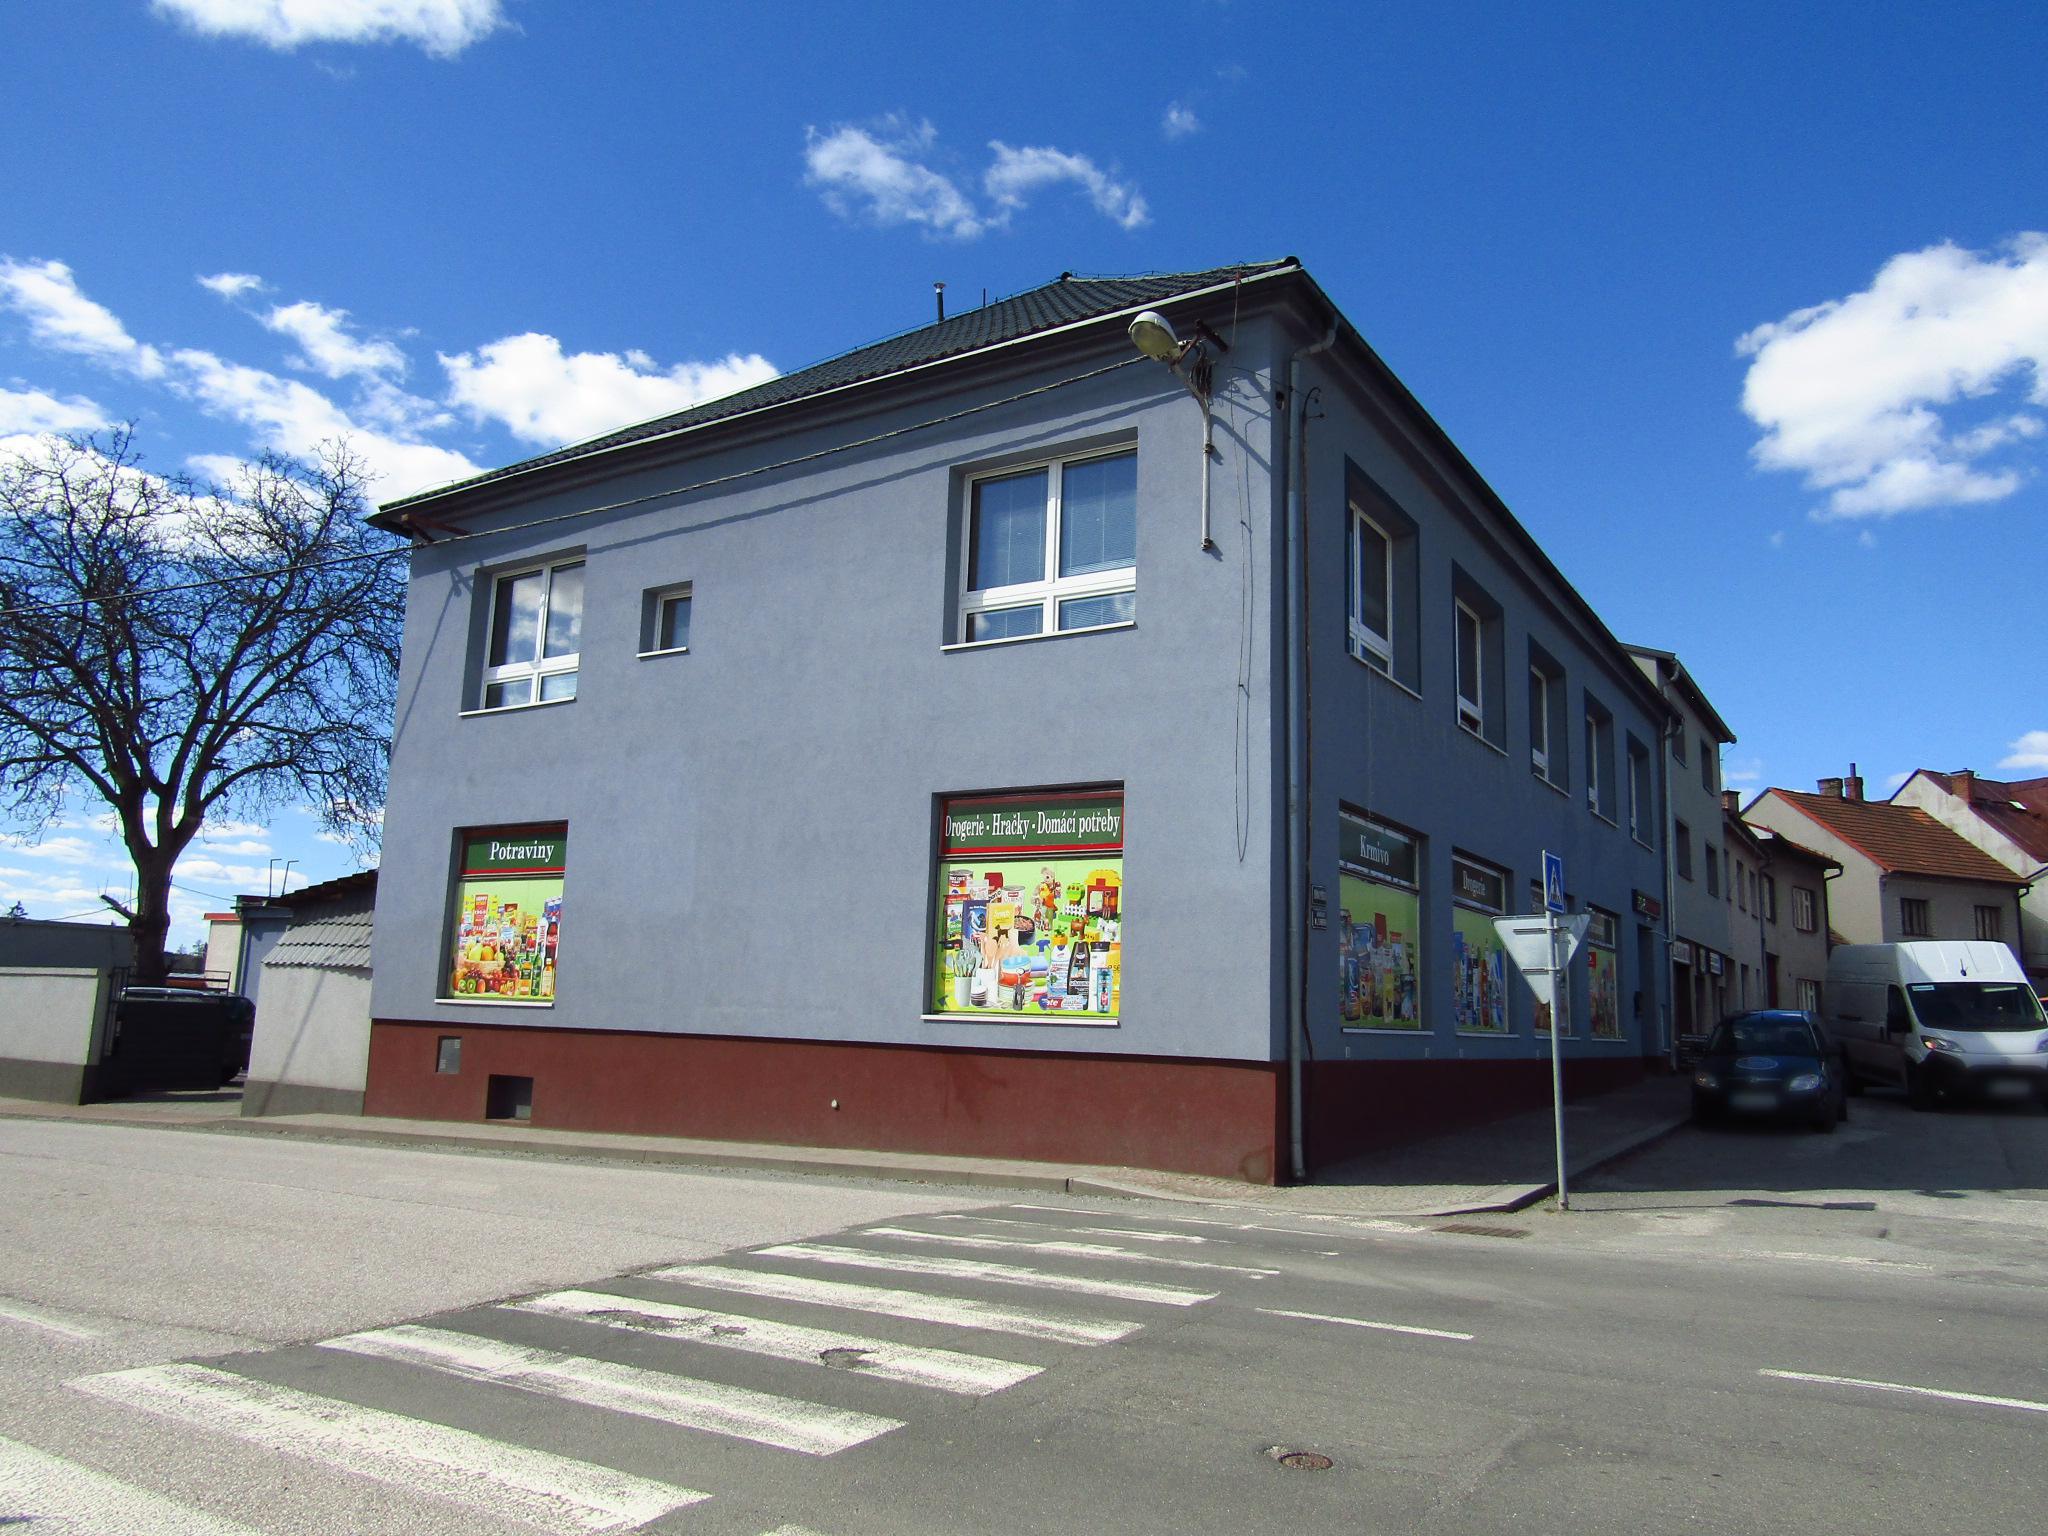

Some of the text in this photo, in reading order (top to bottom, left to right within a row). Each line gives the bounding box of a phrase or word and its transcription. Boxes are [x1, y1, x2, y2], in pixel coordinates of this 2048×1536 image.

[945, 808, 1121, 841] Drogerie Hračky Domácí potřeby
[489, 840, 554, 862] Potraviny
[1360, 835, 1390, 866] Krmivo
